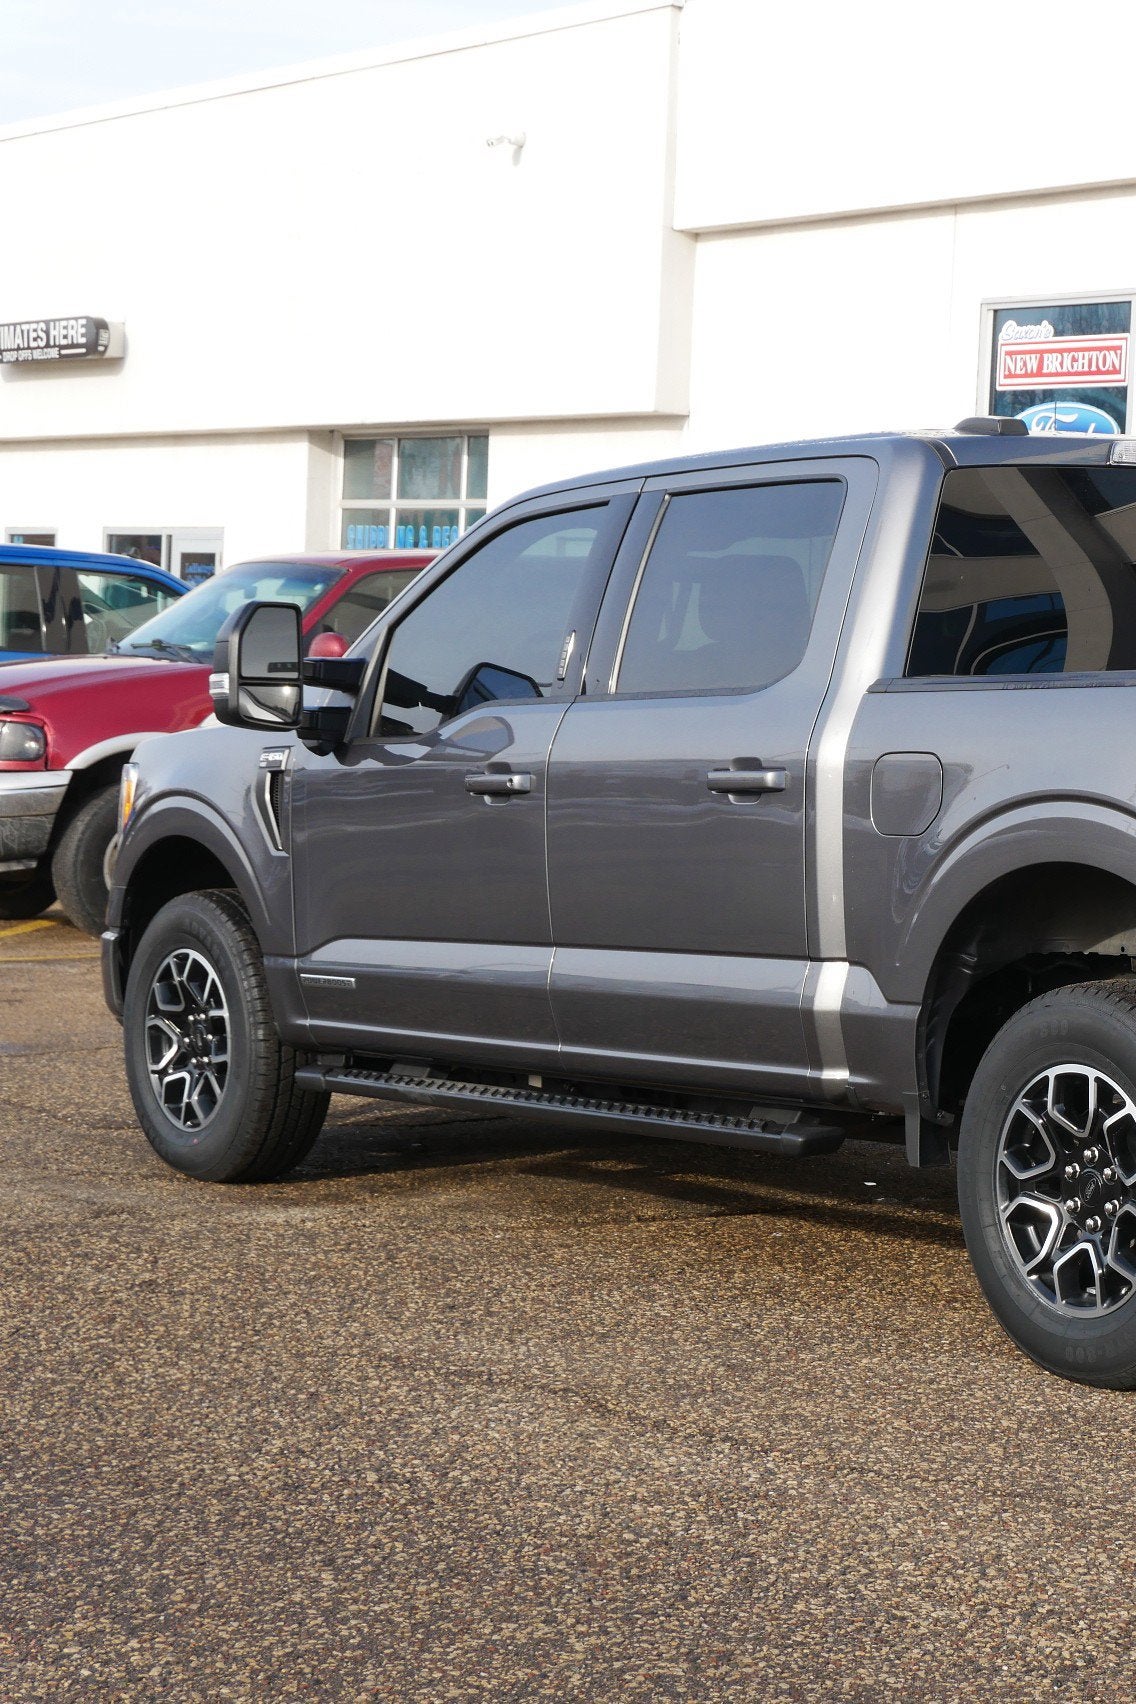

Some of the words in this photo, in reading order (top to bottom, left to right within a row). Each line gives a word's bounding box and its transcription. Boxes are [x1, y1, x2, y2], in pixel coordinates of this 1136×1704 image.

[49, 318, 87, 346] HERE
[1004, 353, 1040, 375] NEW
[1042, 349, 1122, 373] BRIGHTON
